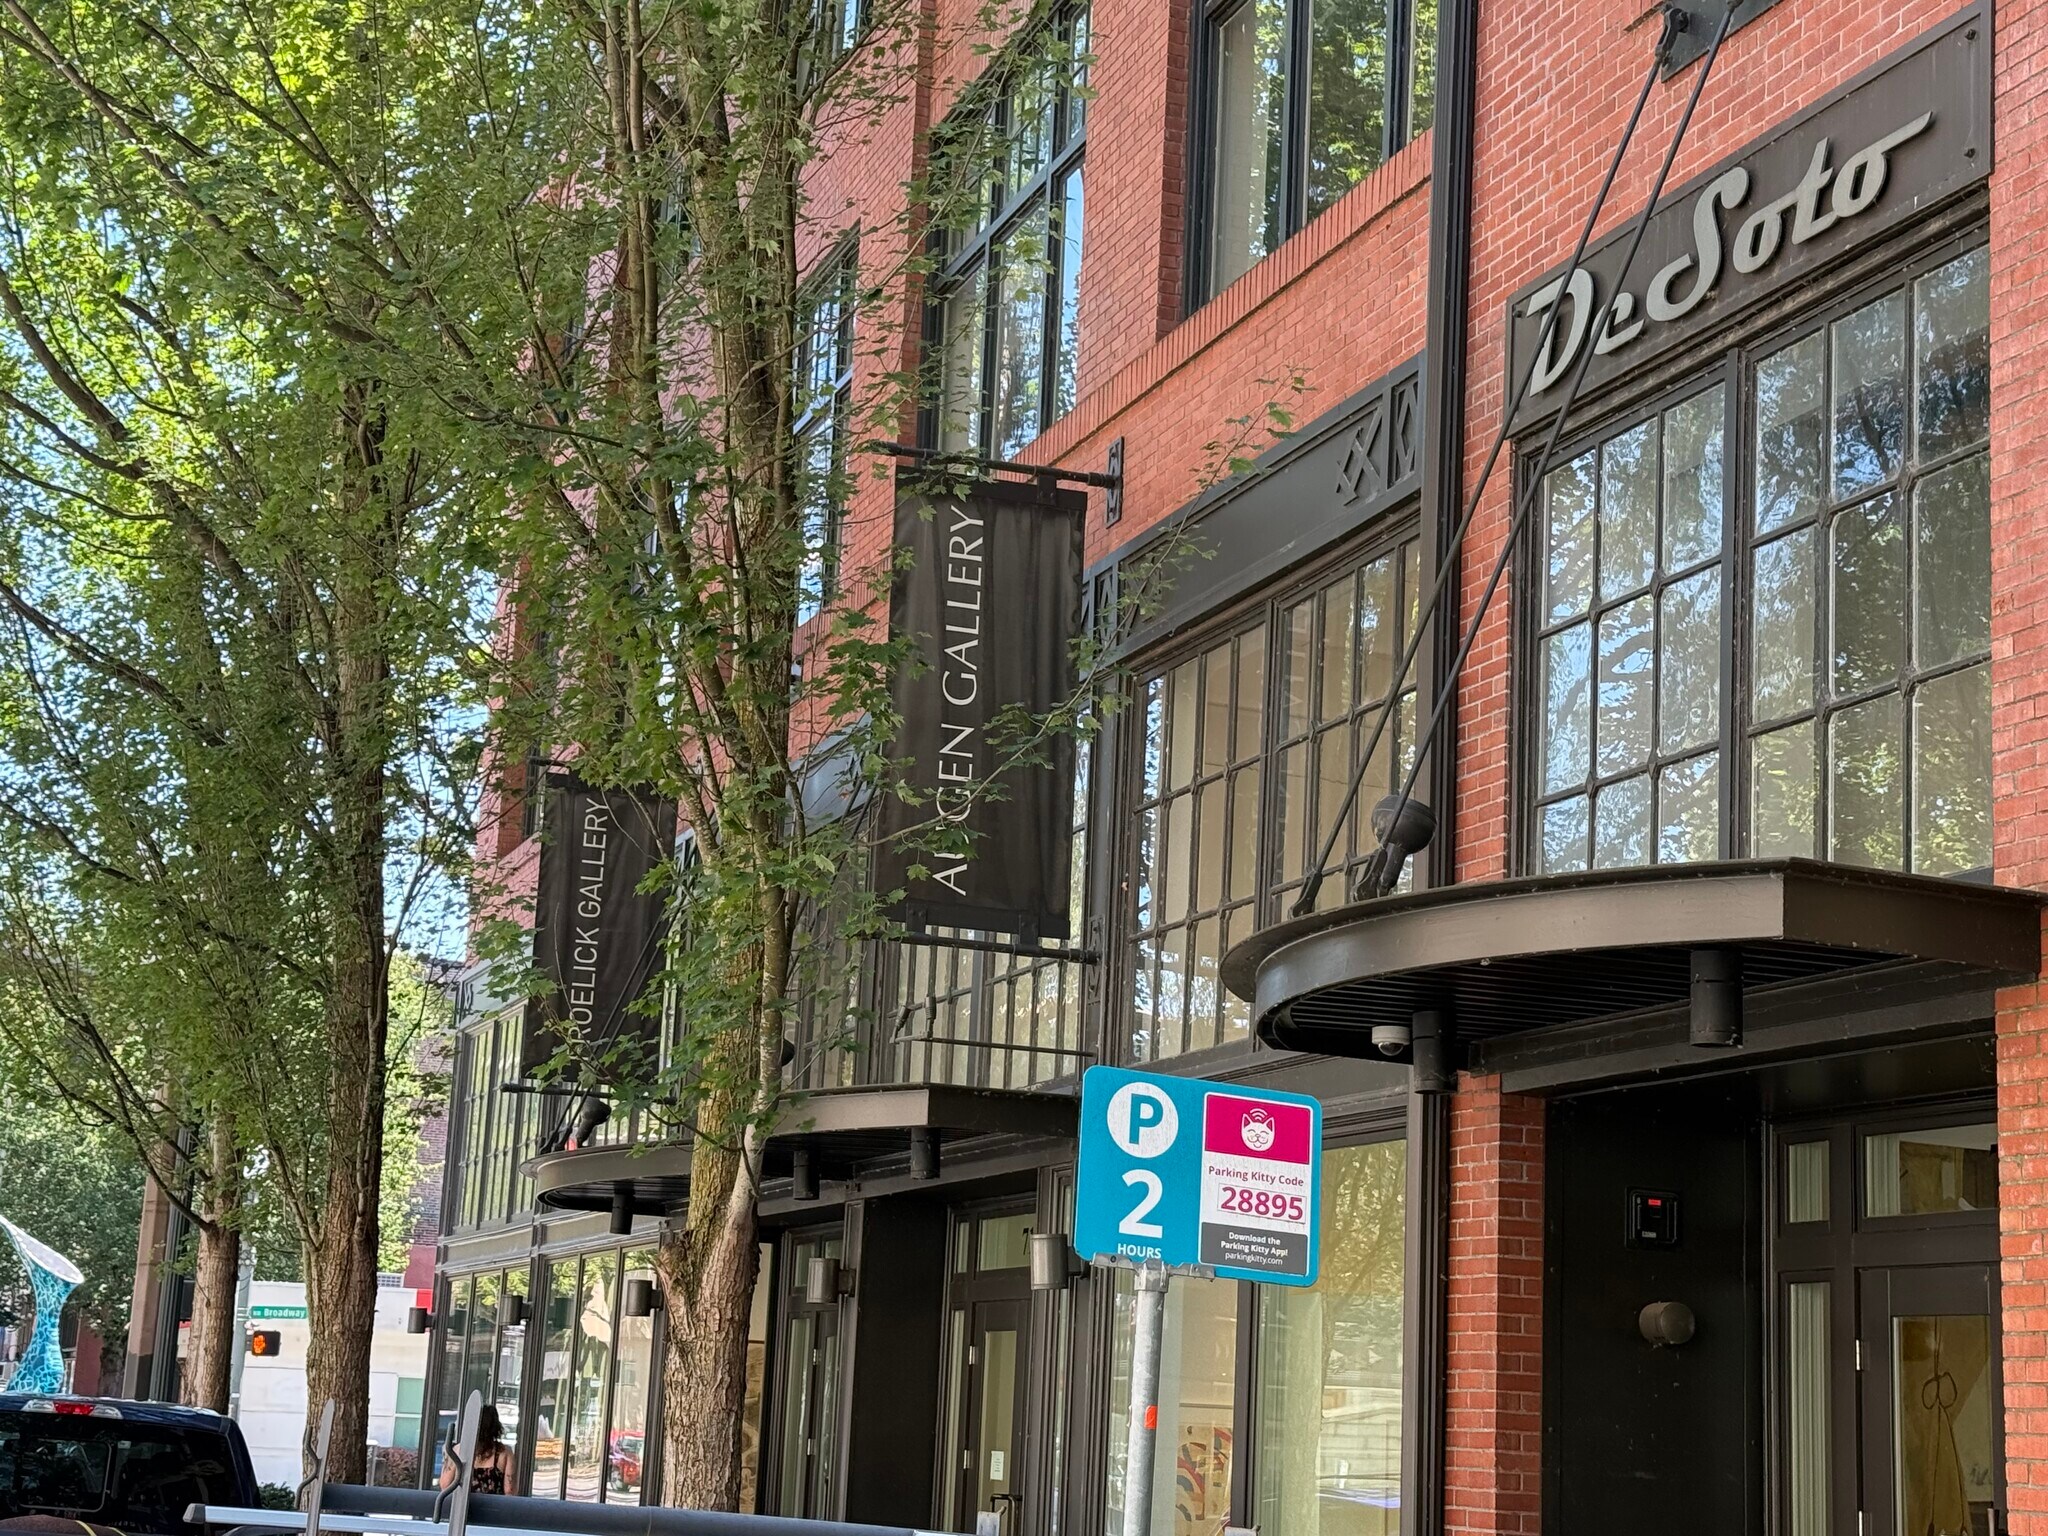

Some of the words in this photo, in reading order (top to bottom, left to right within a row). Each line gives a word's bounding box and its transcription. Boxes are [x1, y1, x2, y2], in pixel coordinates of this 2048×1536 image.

[1646, 110, 1934, 322] Soto
[942, 505, 984, 705] GALLERY
[577, 797, 609, 918] GALLERY
[1129, 1092, 1163, 1145] P
[1208, 1165, 1248, 1182] Parking
[1250, 1171, 1276, 1185] Kitty
[1278, 1174, 1304, 1187] Code
[1118, 1168, 1164, 1239] 2
[1220, 1186, 1304, 1221] 28895
[1117, 1243, 1163, 1260] HOURS
[1220, 1240, 1250, 1253] Parking
[1250, 1244, 1269, 1256] Kitty
[1270, 1247, 1289, 1257] App!
[1228, 1231, 1266, 1244] Download
[1267, 1237, 1281, 1246] the
[1224, 1251, 1283, 1265] parkingkitty.com
[263, 1308, 305, 1318] Broadway
